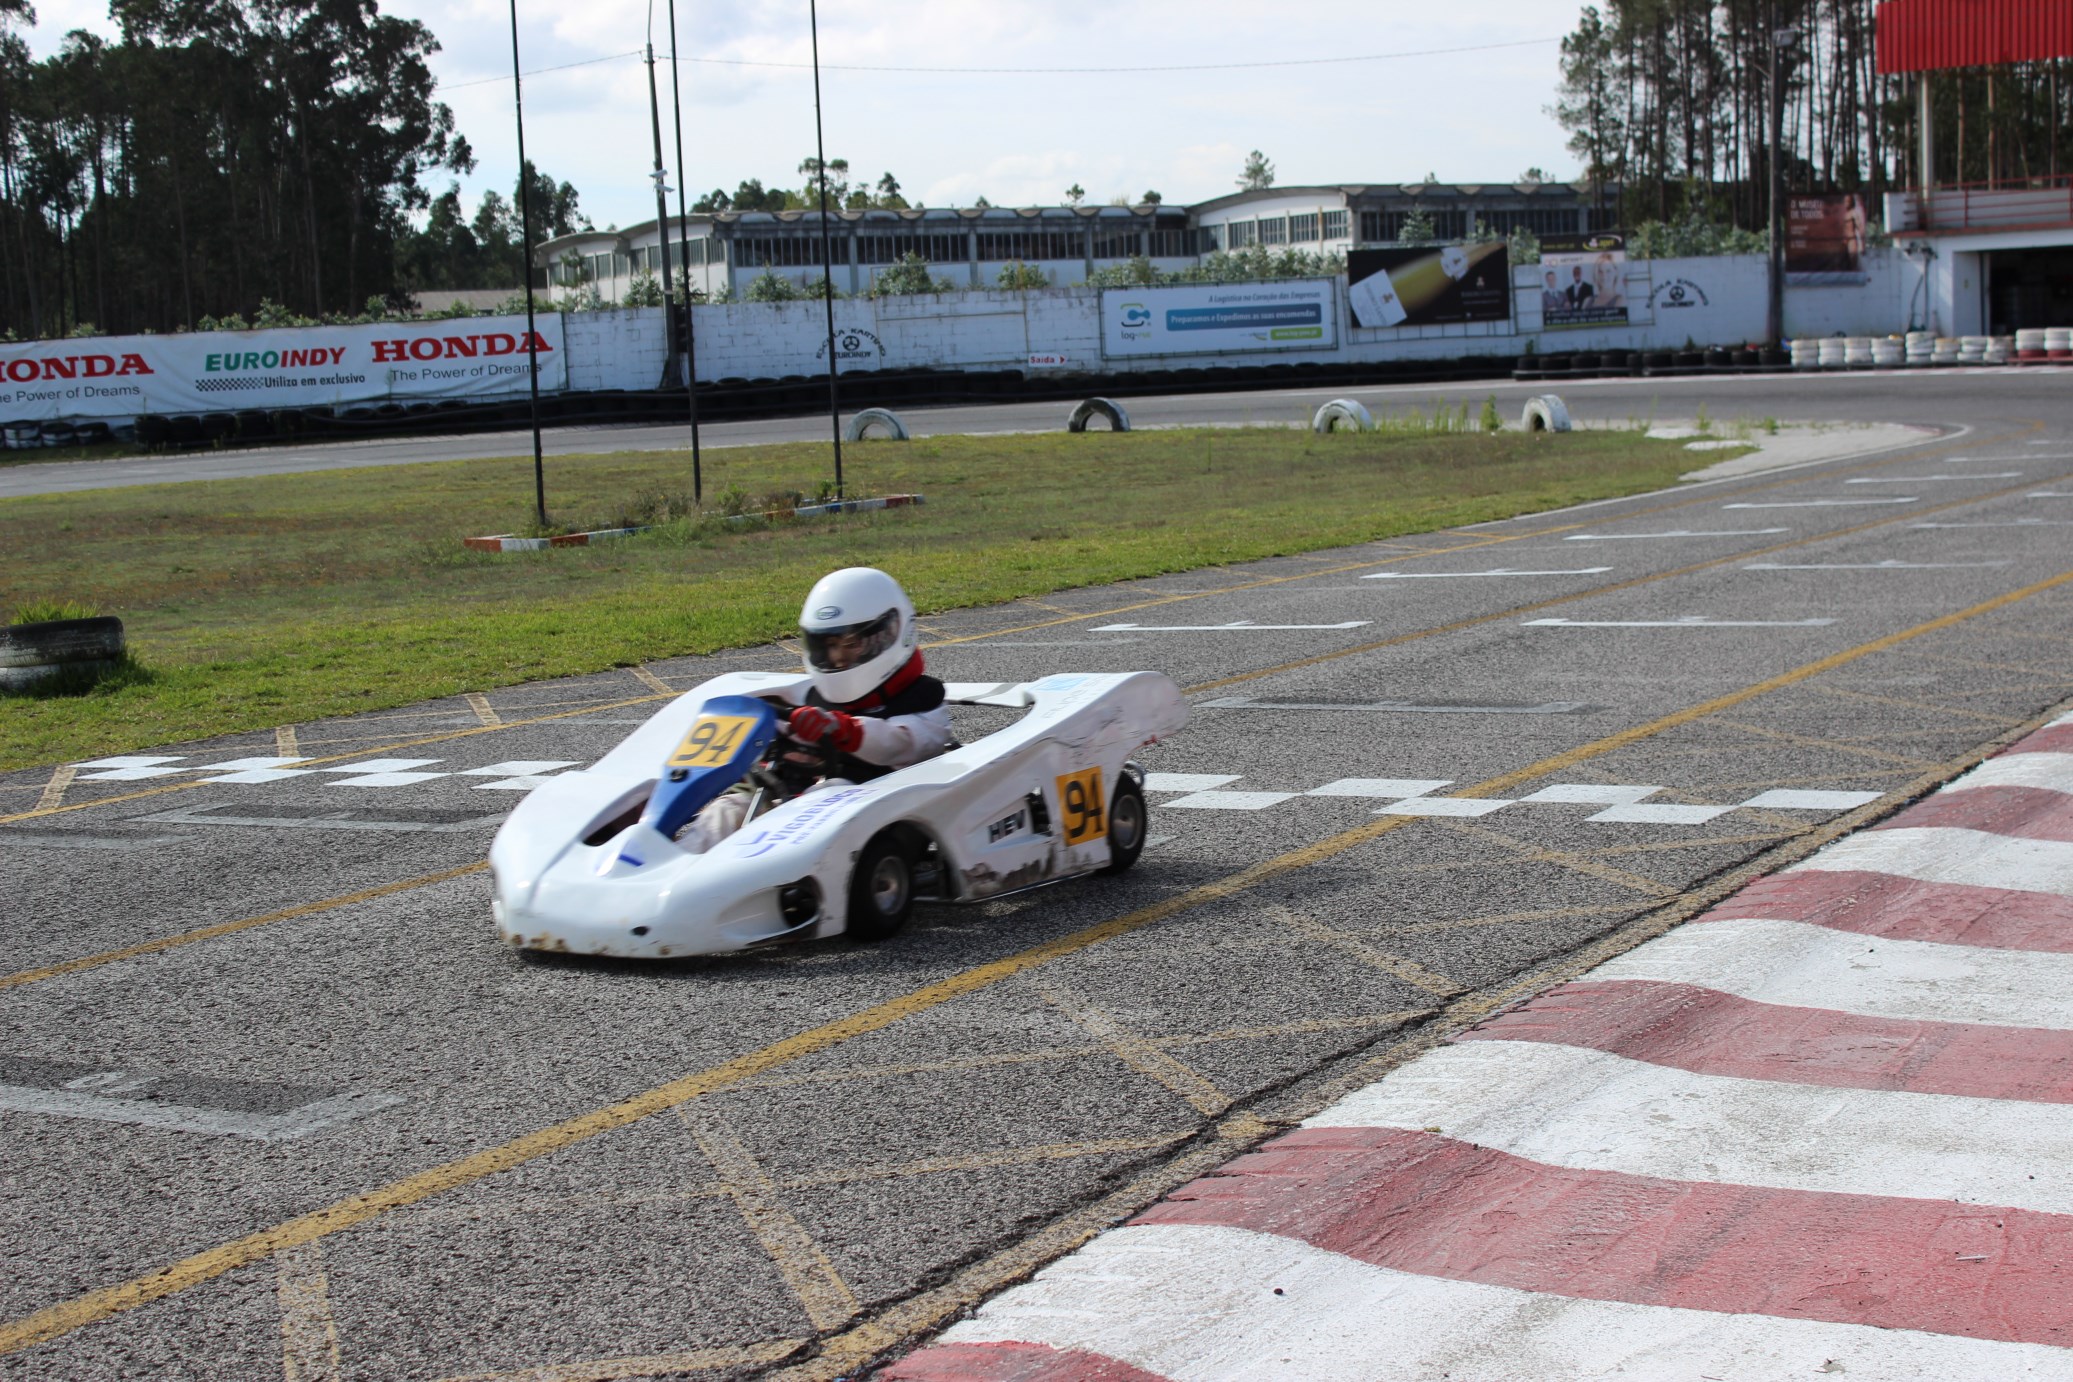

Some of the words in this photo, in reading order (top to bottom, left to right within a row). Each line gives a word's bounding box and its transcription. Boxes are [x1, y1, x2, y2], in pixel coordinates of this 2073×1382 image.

[205, 347, 346, 371] EUROINDY
[371, 331, 553, 363] HONDA
[0, 353, 155, 383] ONDA
[264, 376, 298, 388] Utiliza
[301, 377, 317, 386] em
[320, 373, 366, 386] exclusivo
[391, 370, 417, 382] The
[422, 368, 466, 380] Power
[470, 365, 484, 377] of
[16, 390, 62, 402] Power
[66, 387, 80, 398] of
[84, 386, 140, 398] Dreams
[673, 721, 747, 763] 94
[1064, 772, 1103, 838] 94
